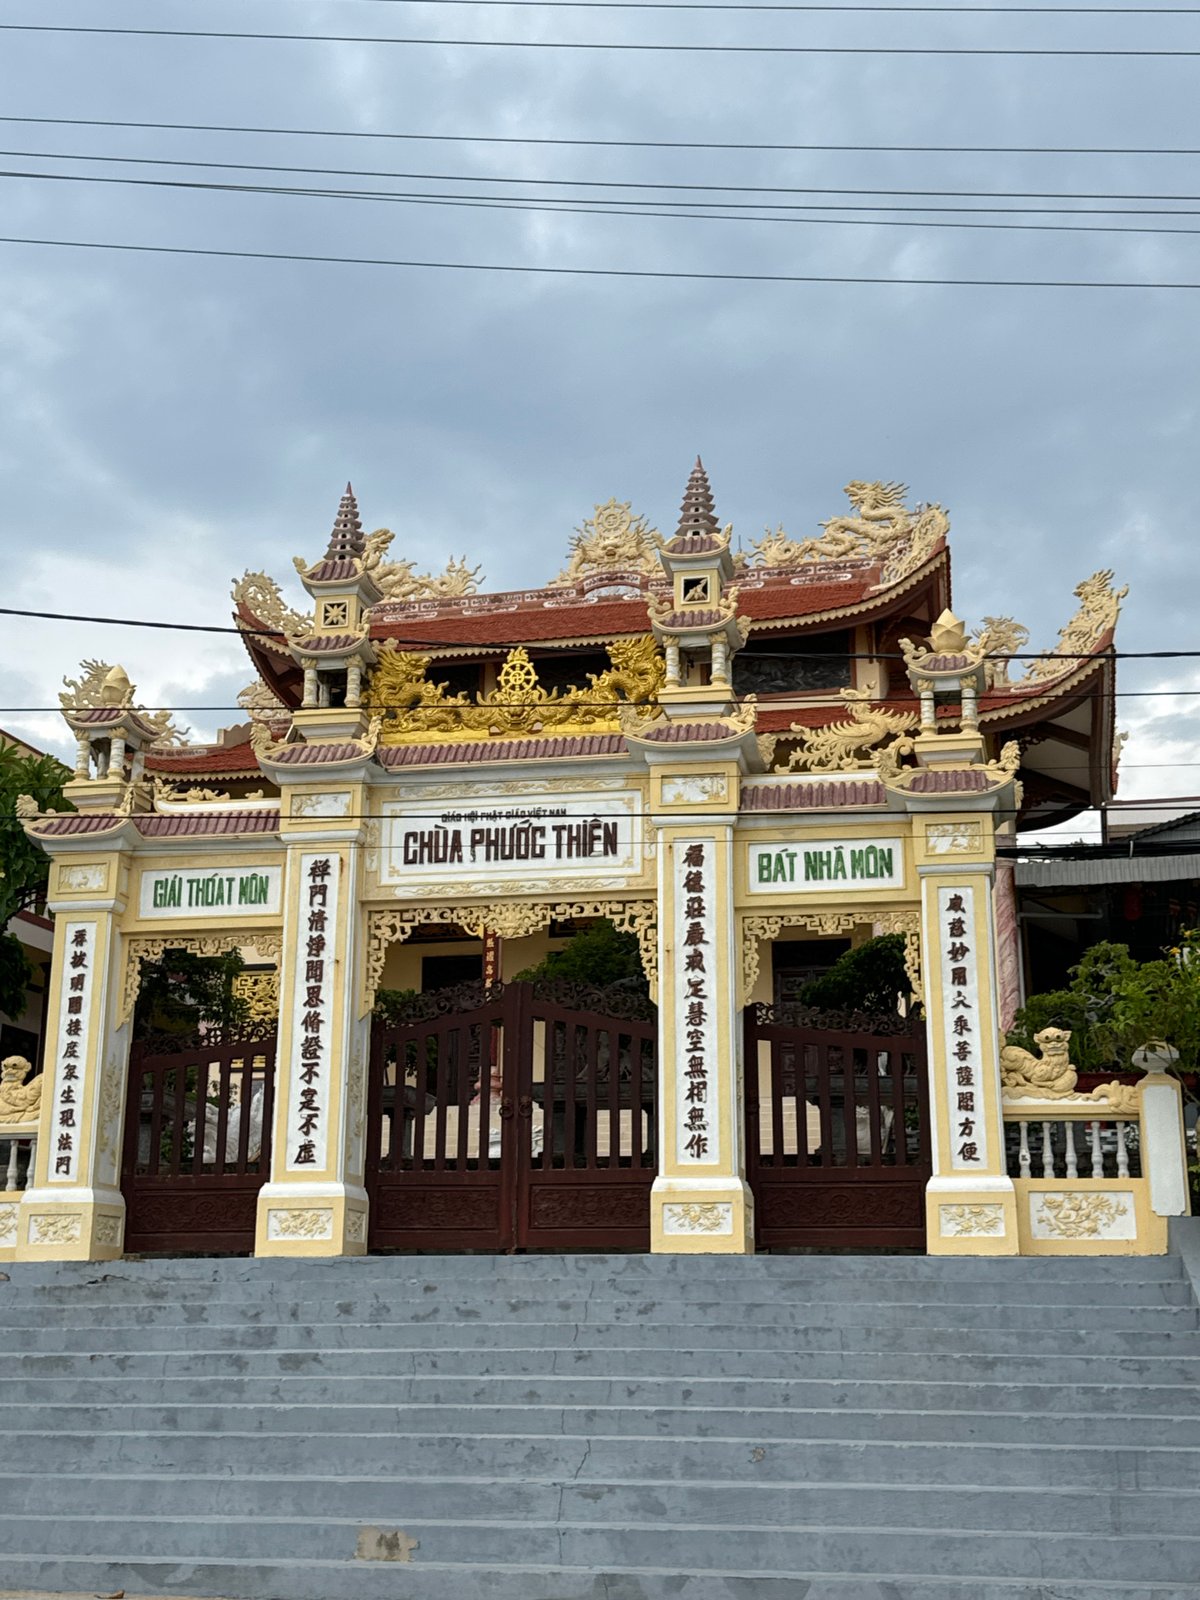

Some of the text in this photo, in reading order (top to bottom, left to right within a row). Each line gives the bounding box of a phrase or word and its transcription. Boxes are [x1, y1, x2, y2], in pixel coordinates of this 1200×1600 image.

[404, 815, 618, 864] CHÙA PHƯỚC THIÊN
[758, 845, 893, 882] BÁT NHÃ MÔN
[238, 873, 270, 905] MÔN
